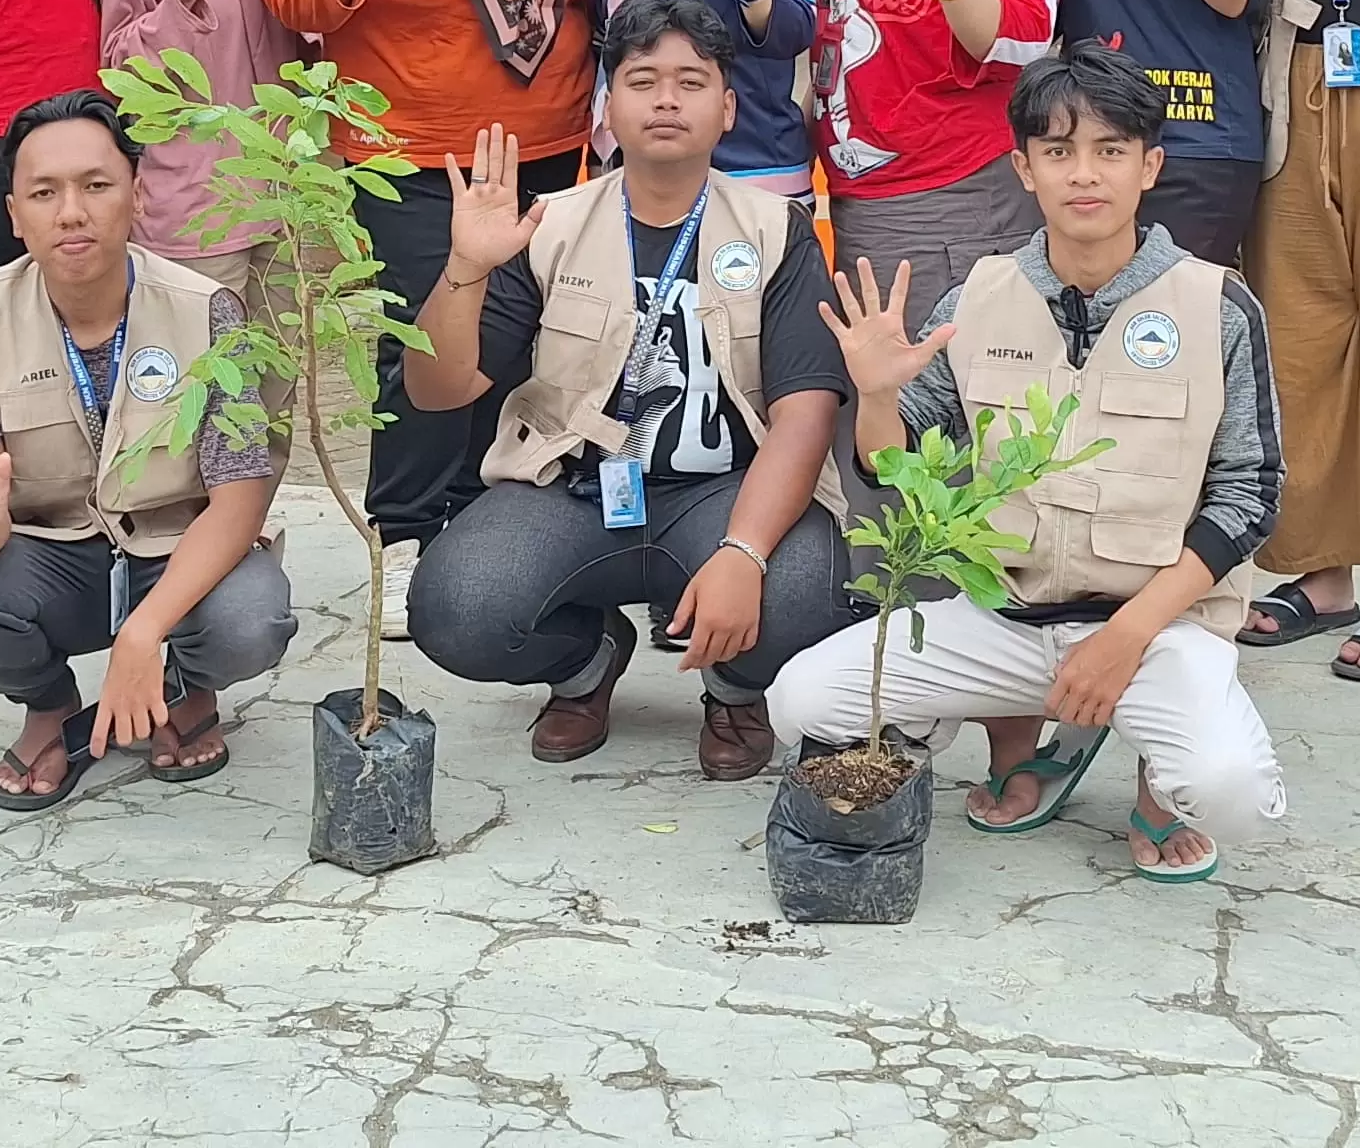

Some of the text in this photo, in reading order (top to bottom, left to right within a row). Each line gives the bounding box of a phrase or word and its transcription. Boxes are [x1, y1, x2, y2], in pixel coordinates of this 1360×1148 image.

[1173, 70, 1213, 88] KERJA
[1166, 103, 1214, 121] KARYA
[666, 220, 696, 276] UNIVERSITAS
[559, 274, 594, 289] RIZKY
[986, 347, 1033, 361] MIFTAH
[21, 368, 59, 384] ARIEL
[81, 387, 95, 408] KKN
